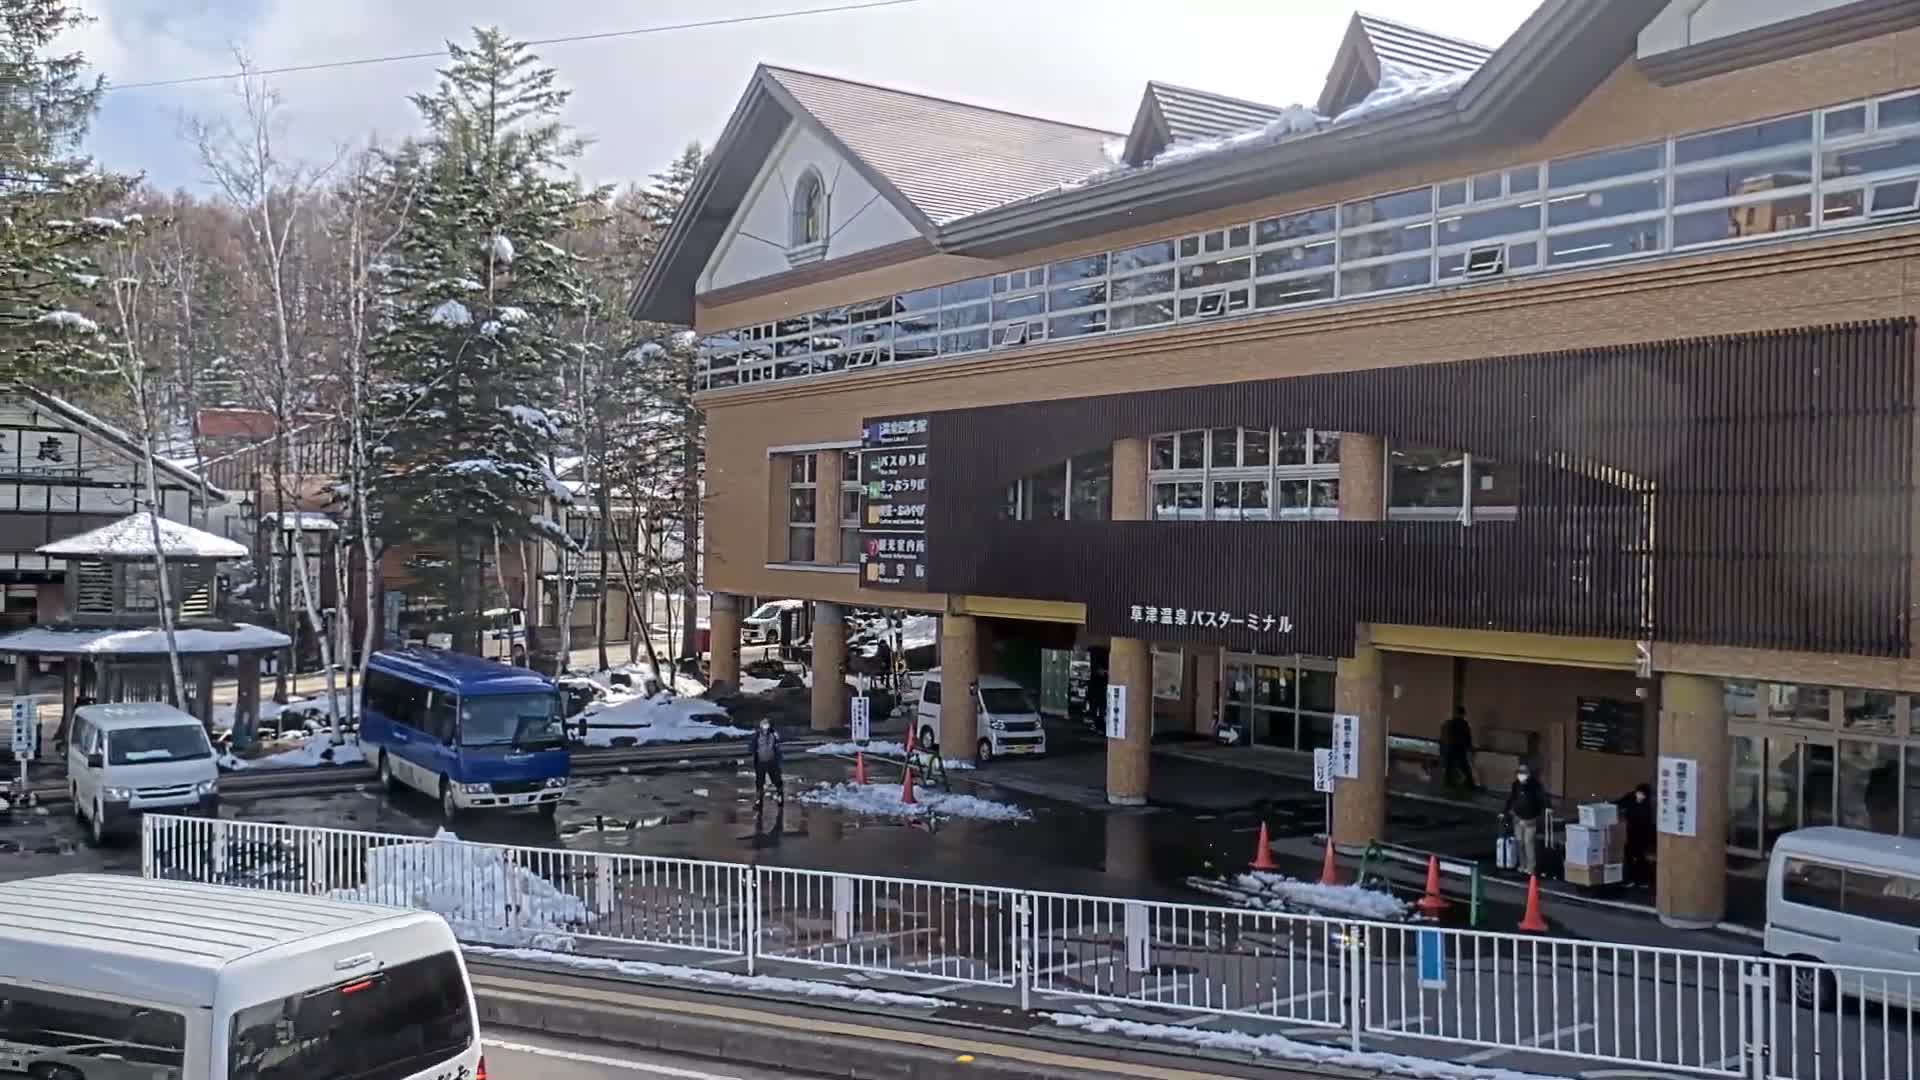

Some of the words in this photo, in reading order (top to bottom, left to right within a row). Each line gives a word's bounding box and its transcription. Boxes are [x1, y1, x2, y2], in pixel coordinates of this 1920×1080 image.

[880, 453, 926, 467] バスのりば
[1130, 605, 1293, 633] 草津温泉バスターミナル
